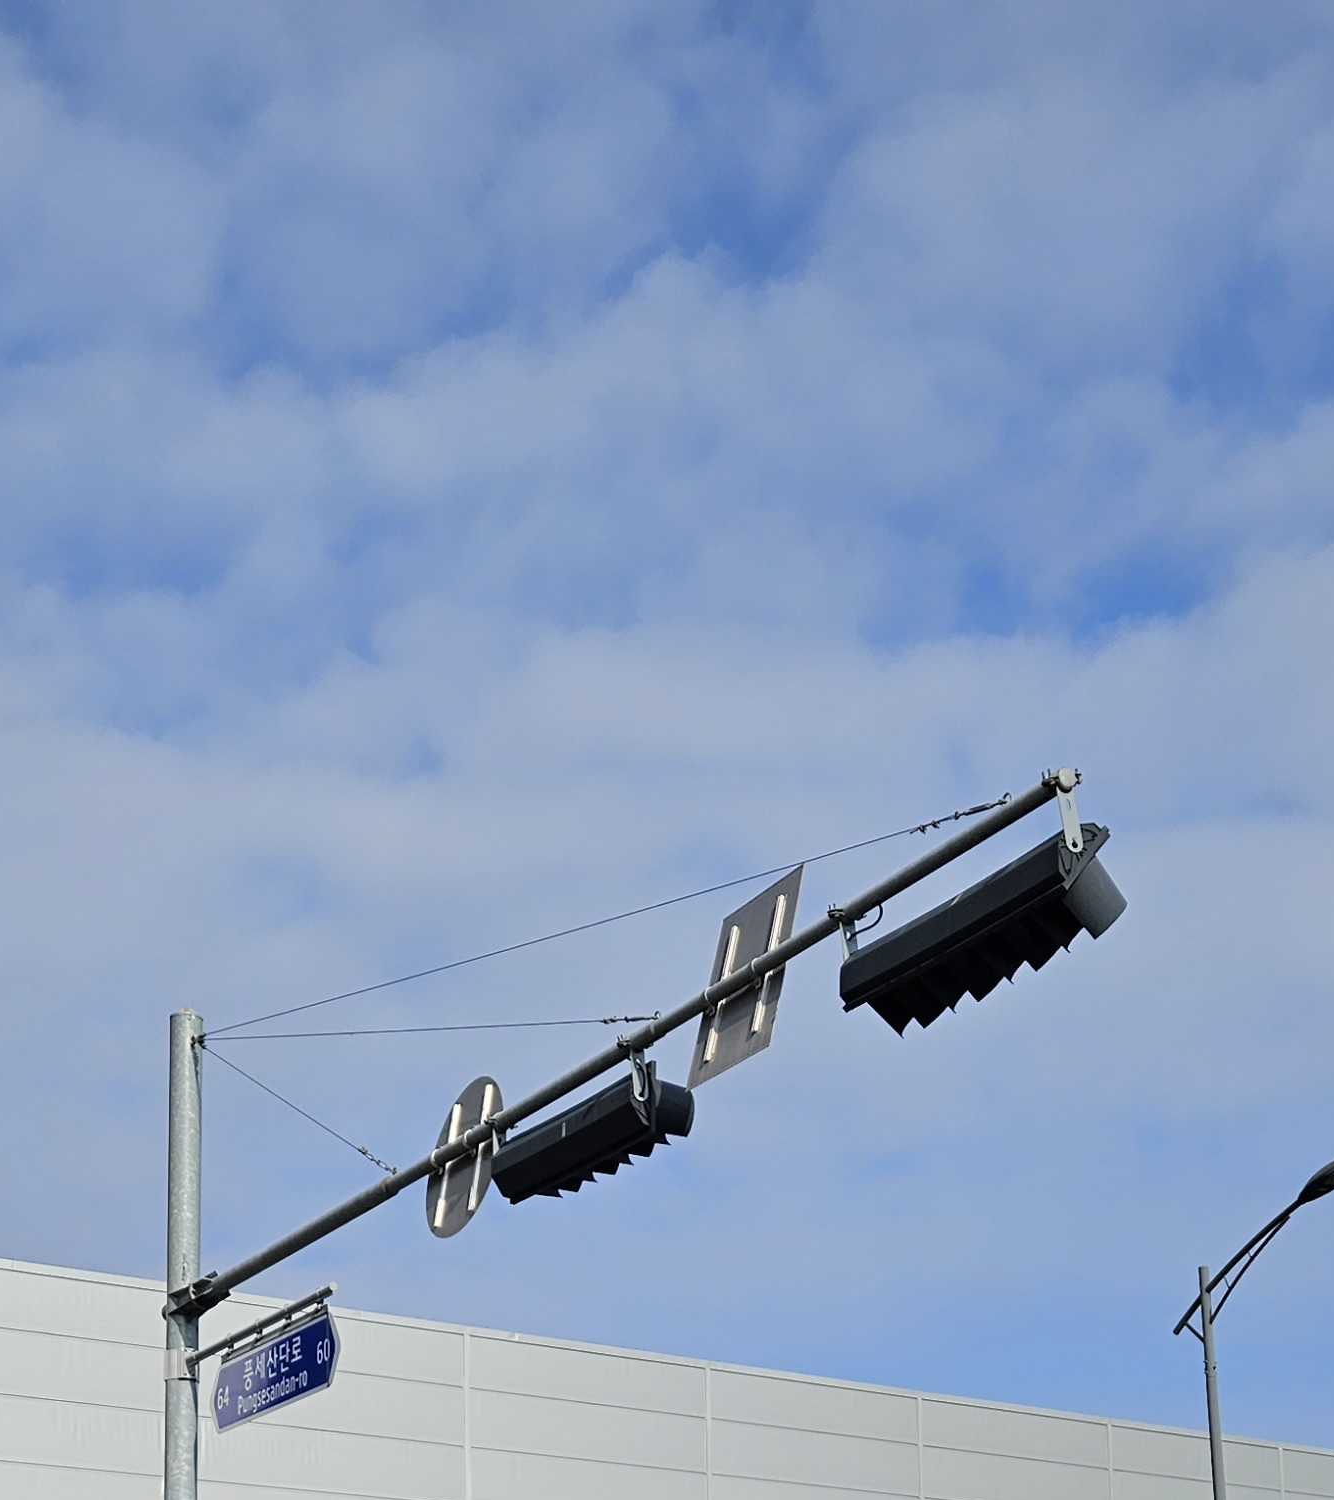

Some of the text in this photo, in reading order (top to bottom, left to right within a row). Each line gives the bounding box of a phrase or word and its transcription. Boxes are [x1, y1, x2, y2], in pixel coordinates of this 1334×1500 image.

[243, 1336, 303, 1391] 풍세산단로
[316, 1338, 331, 1365] 60
[217, 1386, 230, 1410] 64
[237, 1370, 308, 1416] Pungsesandan-ro
